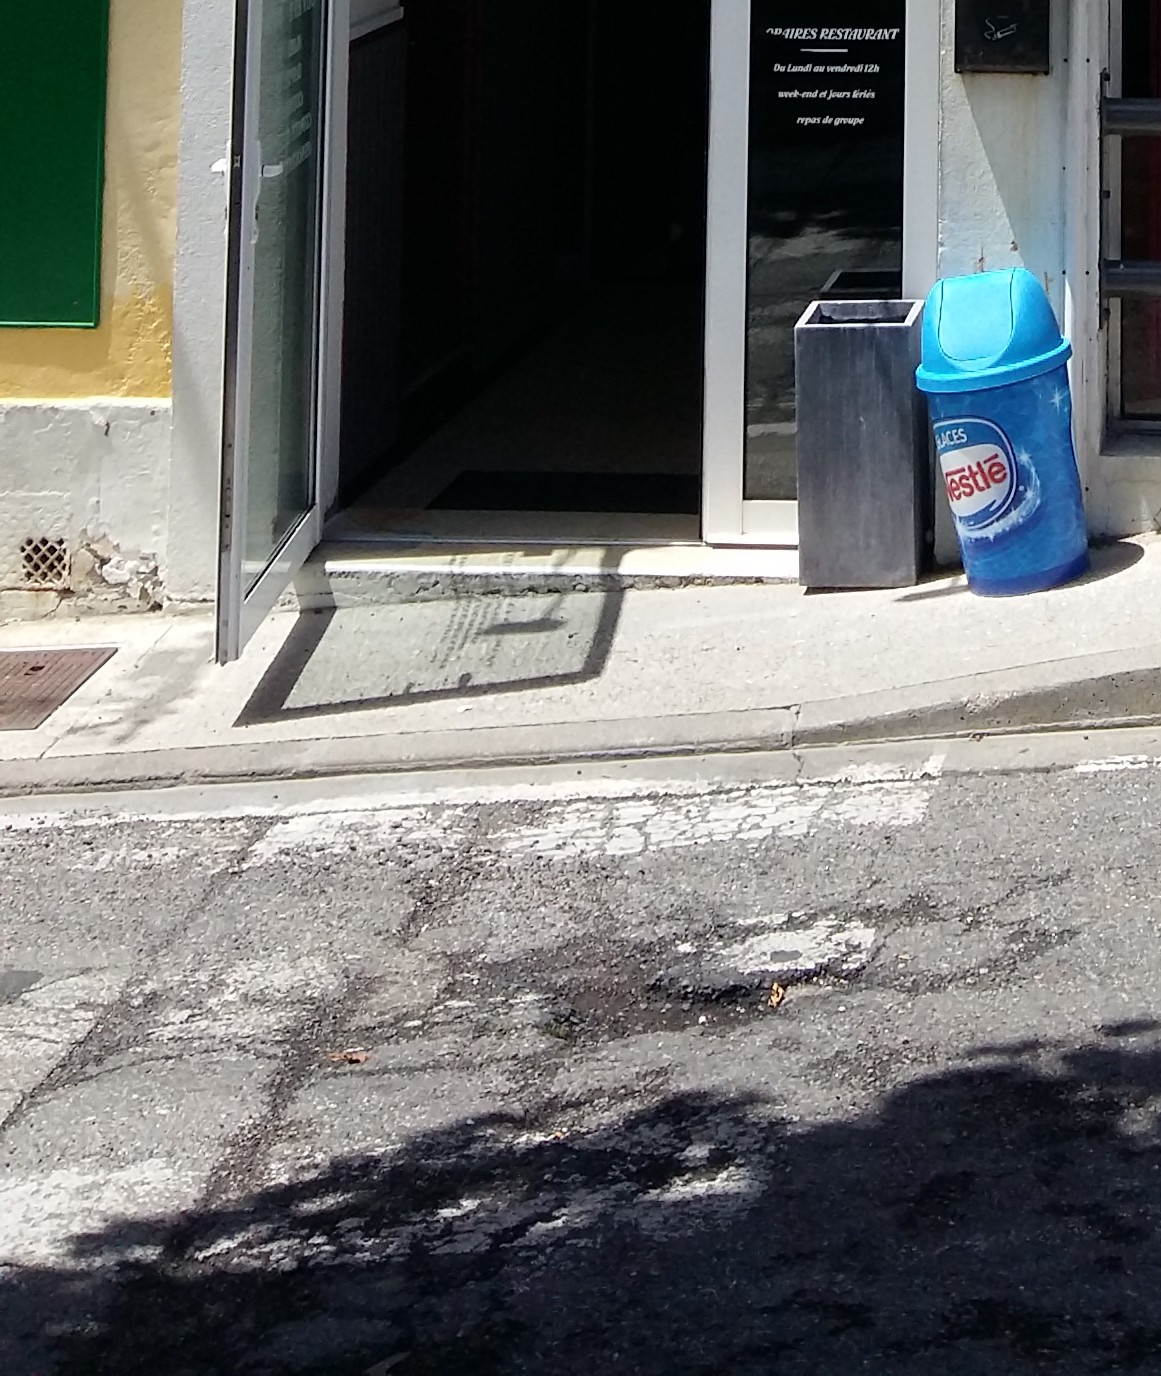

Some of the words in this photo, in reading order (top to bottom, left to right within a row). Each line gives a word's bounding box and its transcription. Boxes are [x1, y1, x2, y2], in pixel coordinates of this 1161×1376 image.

[819, 28, 900, 41] RESTAURANT
[773, 63, 786, 72] Du
[827, 64, 863, 73] vendredi
[863, 64, 880, 73] 12h
[778, 89, 819, 99] week-end
[819, 90, 829, 99] et
[796, 116, 821, 126] repas
[821, 115, 833, 125] de
[834, 117, 865, 127] groupe
